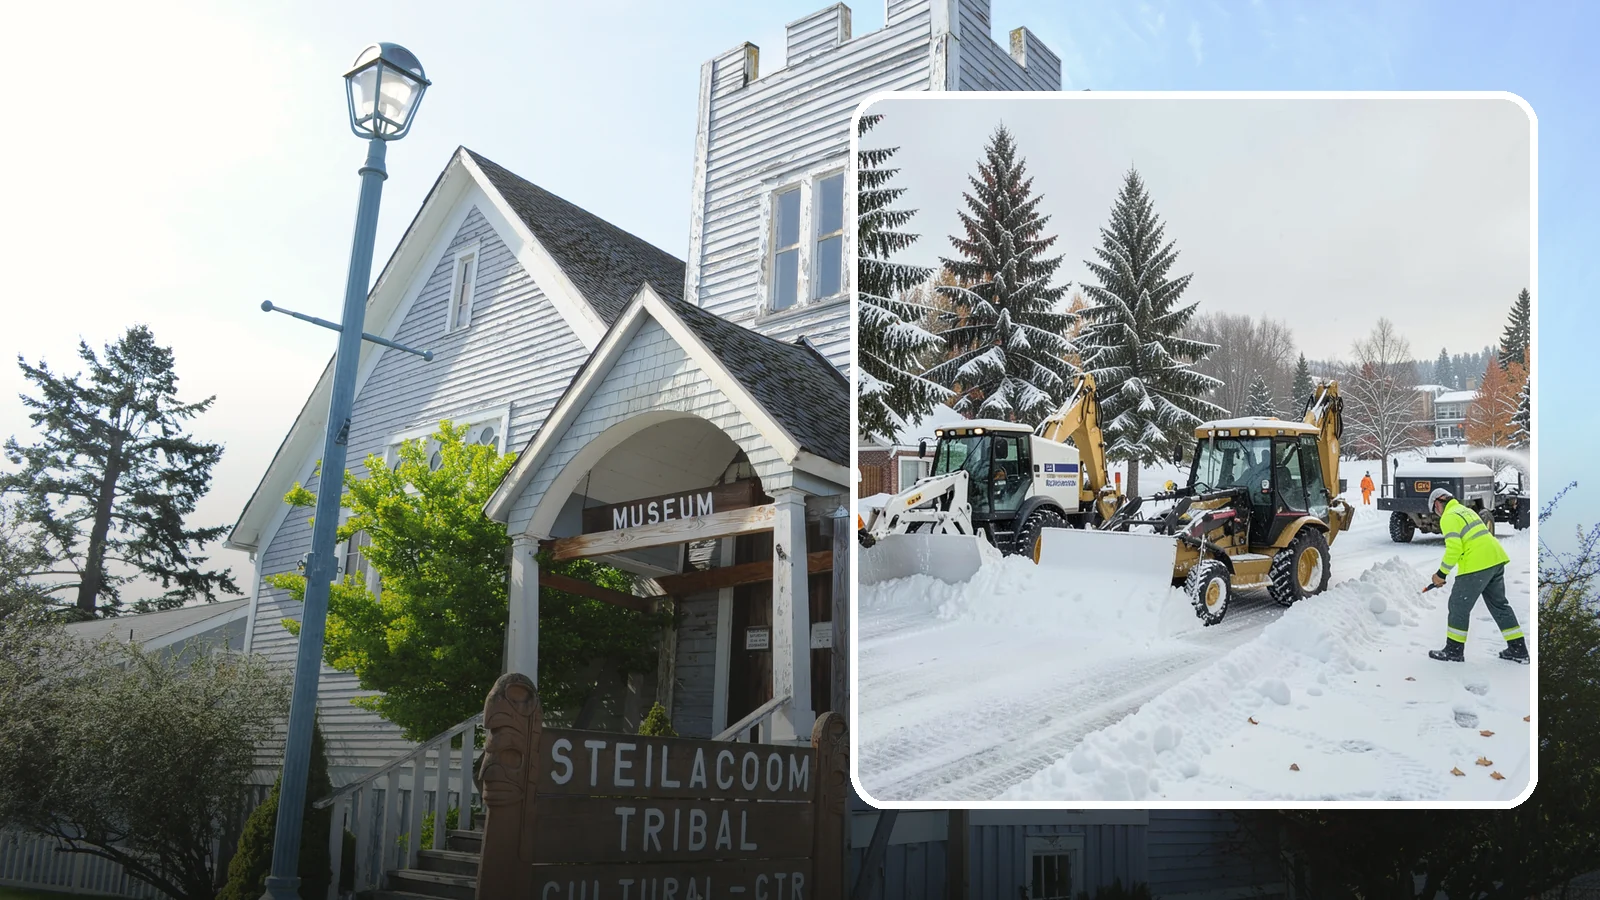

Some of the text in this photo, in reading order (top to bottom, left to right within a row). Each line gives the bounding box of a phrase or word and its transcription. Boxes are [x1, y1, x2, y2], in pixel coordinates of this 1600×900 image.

[613, 491, 714, 530] MUSEUM
[550, 738, 809, 792] STEILACOOM
[614, 807, 758, 852] TRIBAL
